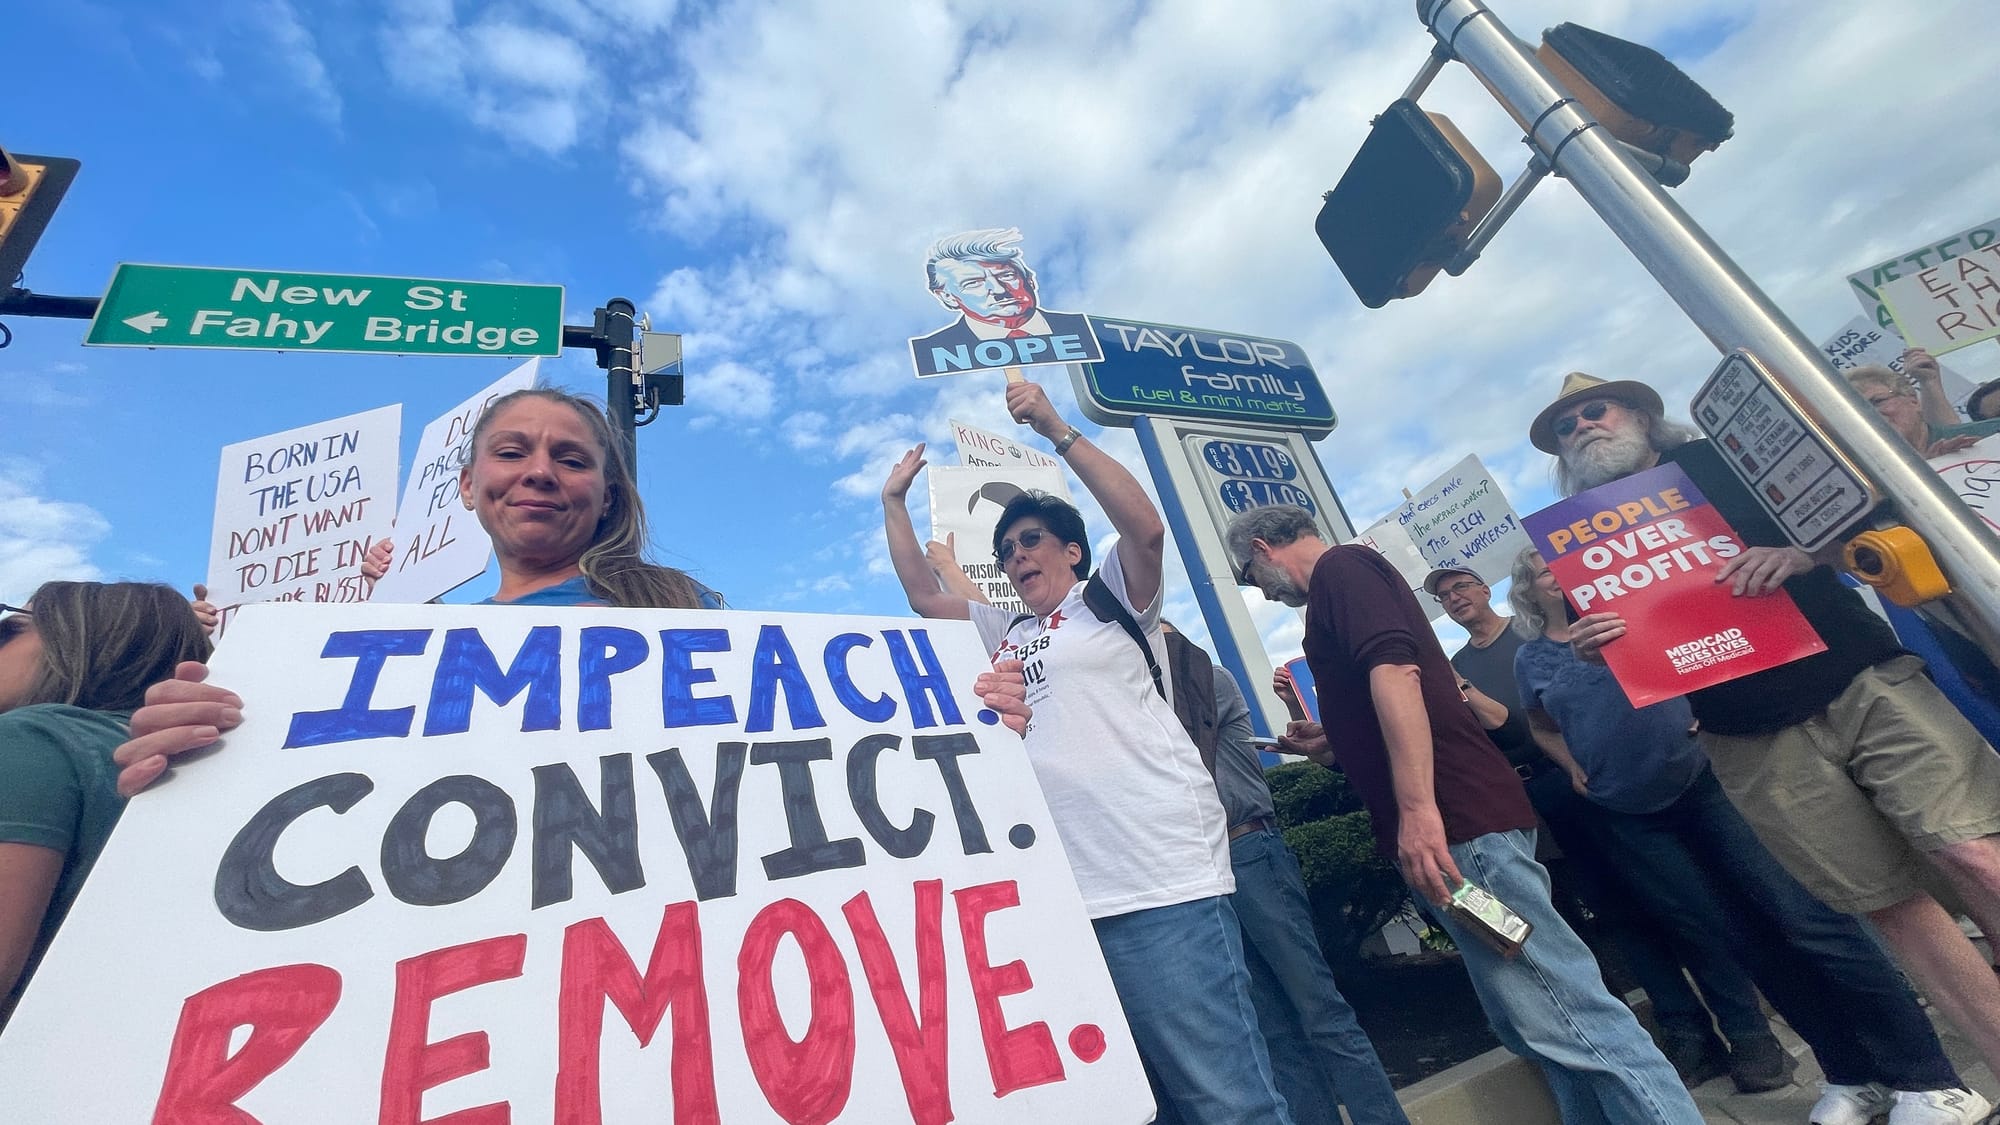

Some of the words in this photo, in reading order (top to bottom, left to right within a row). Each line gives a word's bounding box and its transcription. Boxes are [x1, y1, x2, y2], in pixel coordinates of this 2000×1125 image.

[229, 278, 372, 306] New
[404, 286, 468, 312] St
[1933, 276, 2000, 308] TH
[189, 310, 334, 344] Fahy
[364, 316, 539, 349] Bridge
[1936, 299, 2000, 340] RI
[931, 334, 1088, 373] NOPE
[1104, 323, 1290, 369] TAYLOR
[1842, 330, 1882, 362] MORE
[1132, 386, 1175, 401] fuel
[1179, 390, 1198, 404] &
[1202, 394, 1243, 409] mini
[1248, 398, 1306, 413] marts
[244, 442, 318, 484] BORN
[322, 430, 359, 461] IN
[957, 426, 1005, 455] KING
[1208, 447, 1223, 469] REG
[249, 478, 303, 516] THE
[307, 465, 361, 502] USA
[427, 477, 460, 517] FO
[1224, 483, 1242, 513] PLUS
[1794, 500, 1811, 518] PUSH
[1809, 481, 1834, 505] BUTTON
[304, 497, 371, 536] WANT
[1450, 510, 1486, 538] RICH
[1547, 487, 1690, 555] PEOPLE
[1810, 518, 1821, 529] TO
[1819, 501, 1842, 522] CROSS
[399, 515, 456, 573] ALL
[1459, 514, 1517, 560] WORKERS!
[1582, 518, 1693, 570] OVER
[236, 562, 268, 593] TO
[272, 548, 322, 584] DIE
[332, 535, 372, 570] IN
[1570, 535, 1741, 612] PROFITS
[1665, 628, 1742, 659] MEDICAID
[1672, 648, 1712, 668] SAVES
[1712, 637, 1749, 657] LIVES
[1676, 663, 1703, 675] Hands
[1703, 657, 1717, 667] Off
[1717, 646, 1755, 663] Medicaid
[283, 625, 1000, 748] IMPEACH.
[215, 732, 1036, 932] CONVICT.
[150, 877, 1107, 1125] REMOVE.
